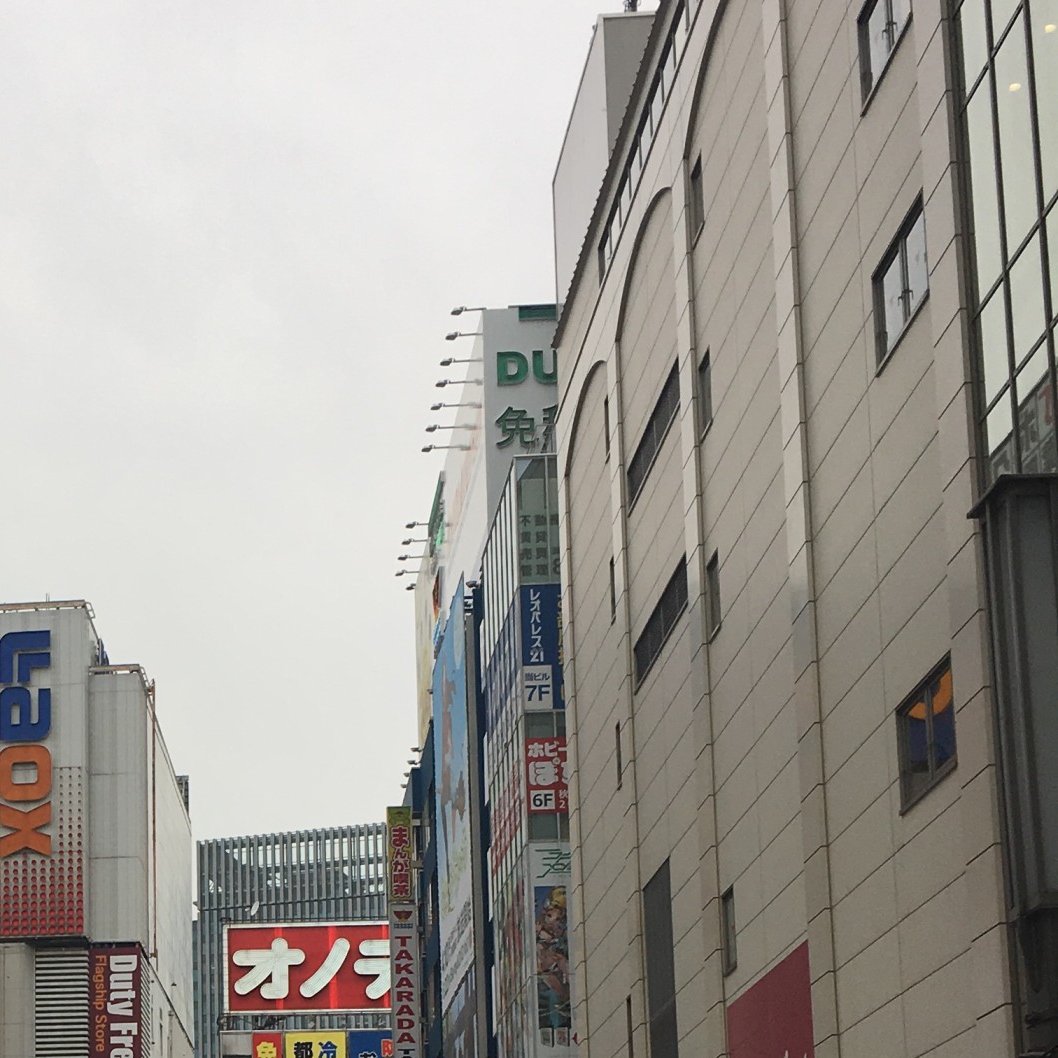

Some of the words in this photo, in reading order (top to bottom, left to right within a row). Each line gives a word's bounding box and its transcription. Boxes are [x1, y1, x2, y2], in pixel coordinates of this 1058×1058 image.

[530, 589, 544, 663] レオパレス21
[525, 672, 550, 682] 当ビル
[525, 685, 551, 702] 7F
[532, 793, 554, 808] 6F
[392, 826, 410, 897] まんが喫茶
[94, 954, 106, 1011] Flagship
[105, 955, 138, 1018] Duty
[395, 936, 417, 1044] TAKARADA
[95, 1013, 105, 1053] Store
